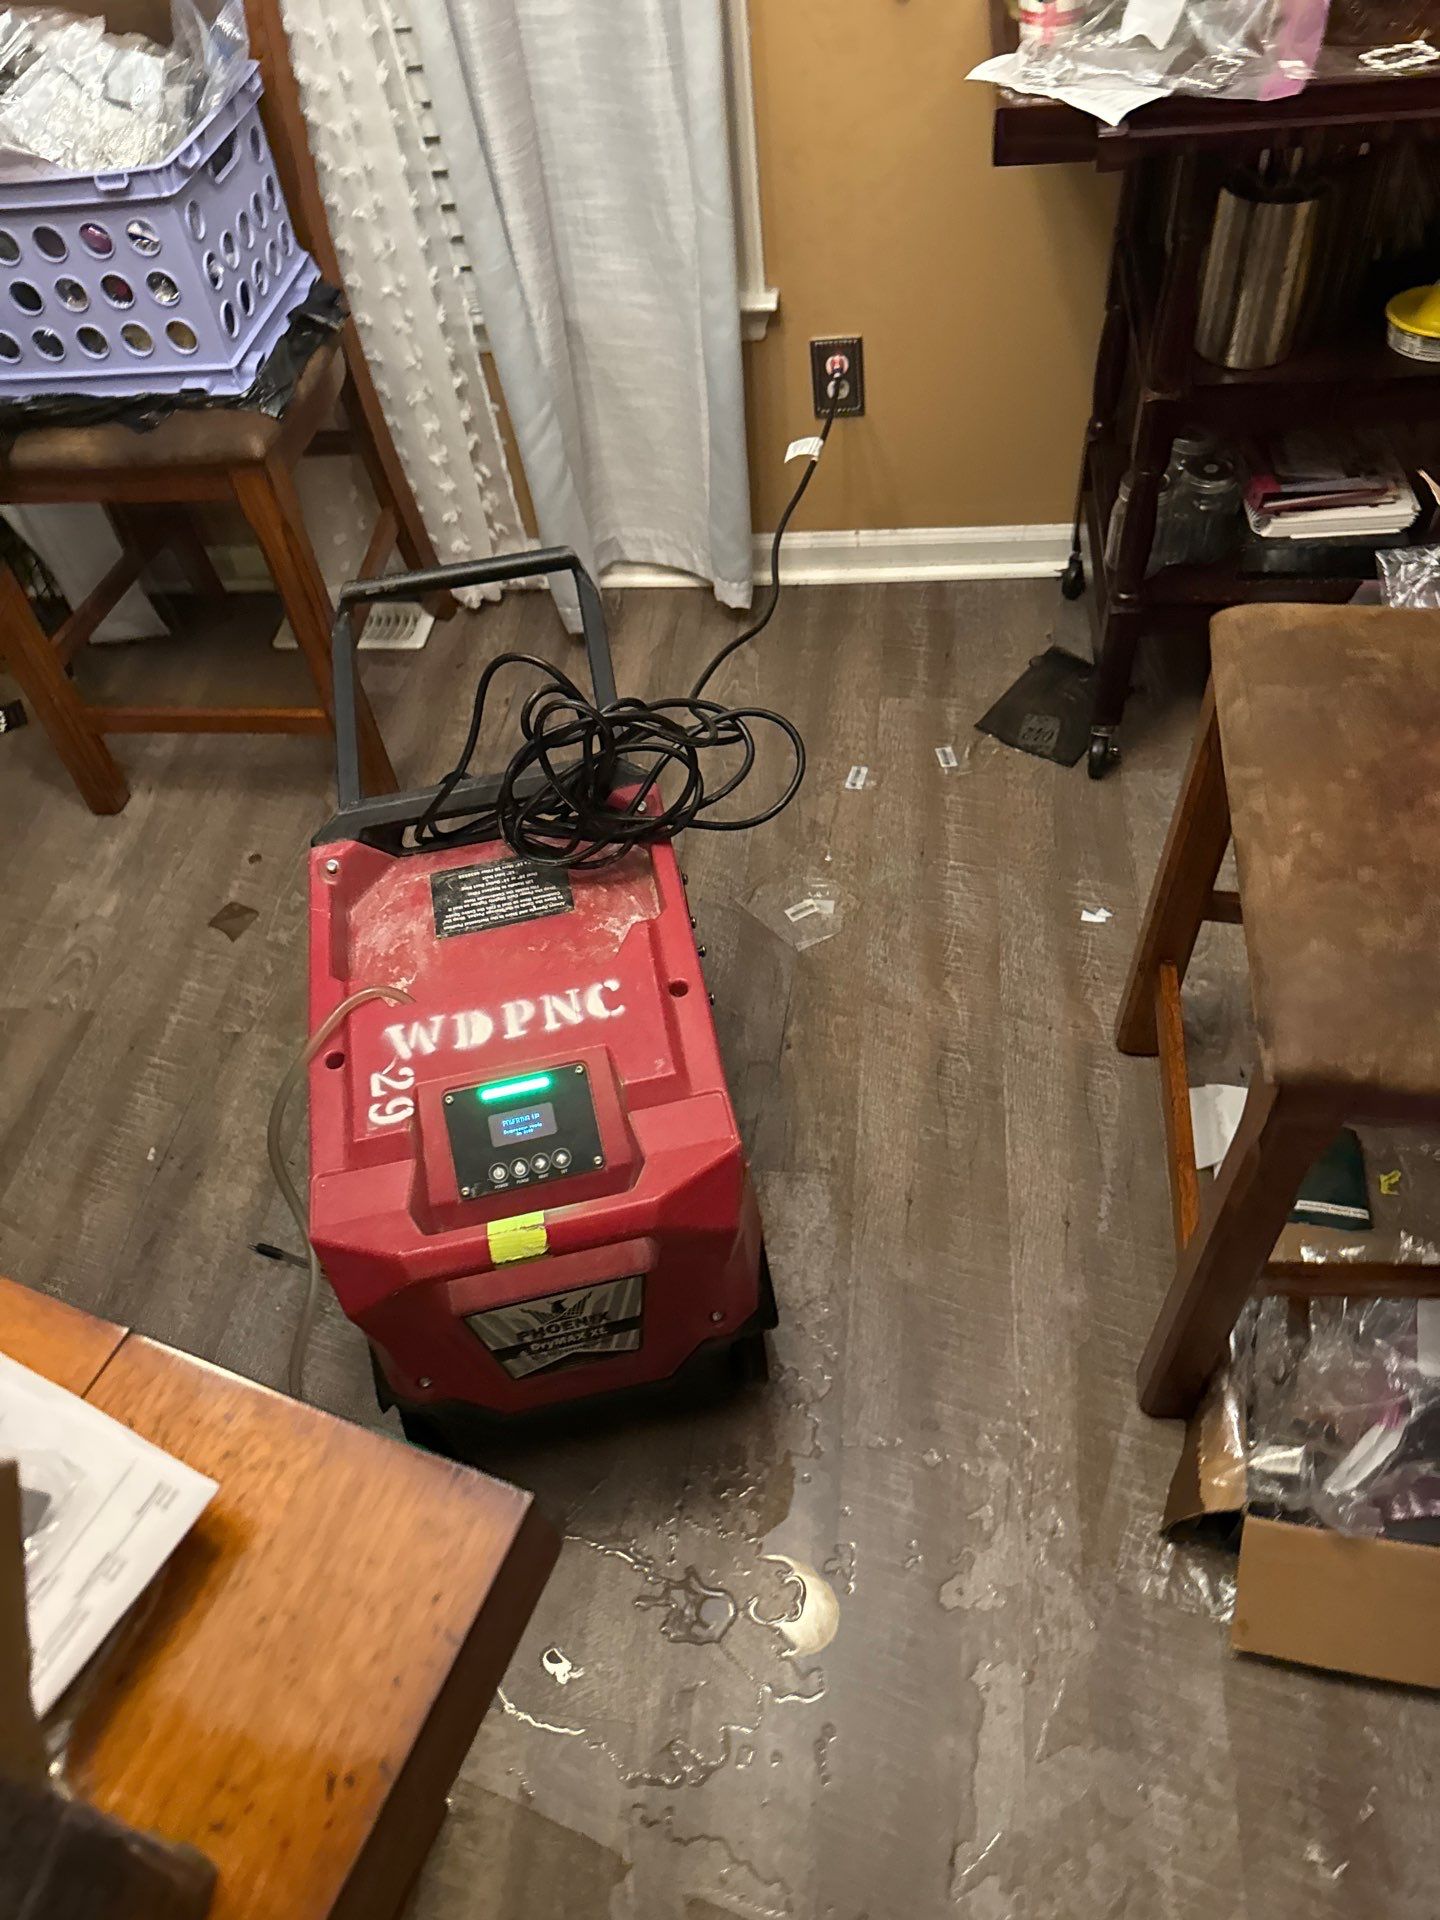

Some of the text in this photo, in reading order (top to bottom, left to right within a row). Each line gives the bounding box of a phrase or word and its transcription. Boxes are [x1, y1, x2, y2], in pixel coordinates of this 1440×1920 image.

[384, 978, 625, 1060] WDPNC
[368, 1066, 415, 1125] 29
[516, 1311, 610, 1341] PHOENIX
